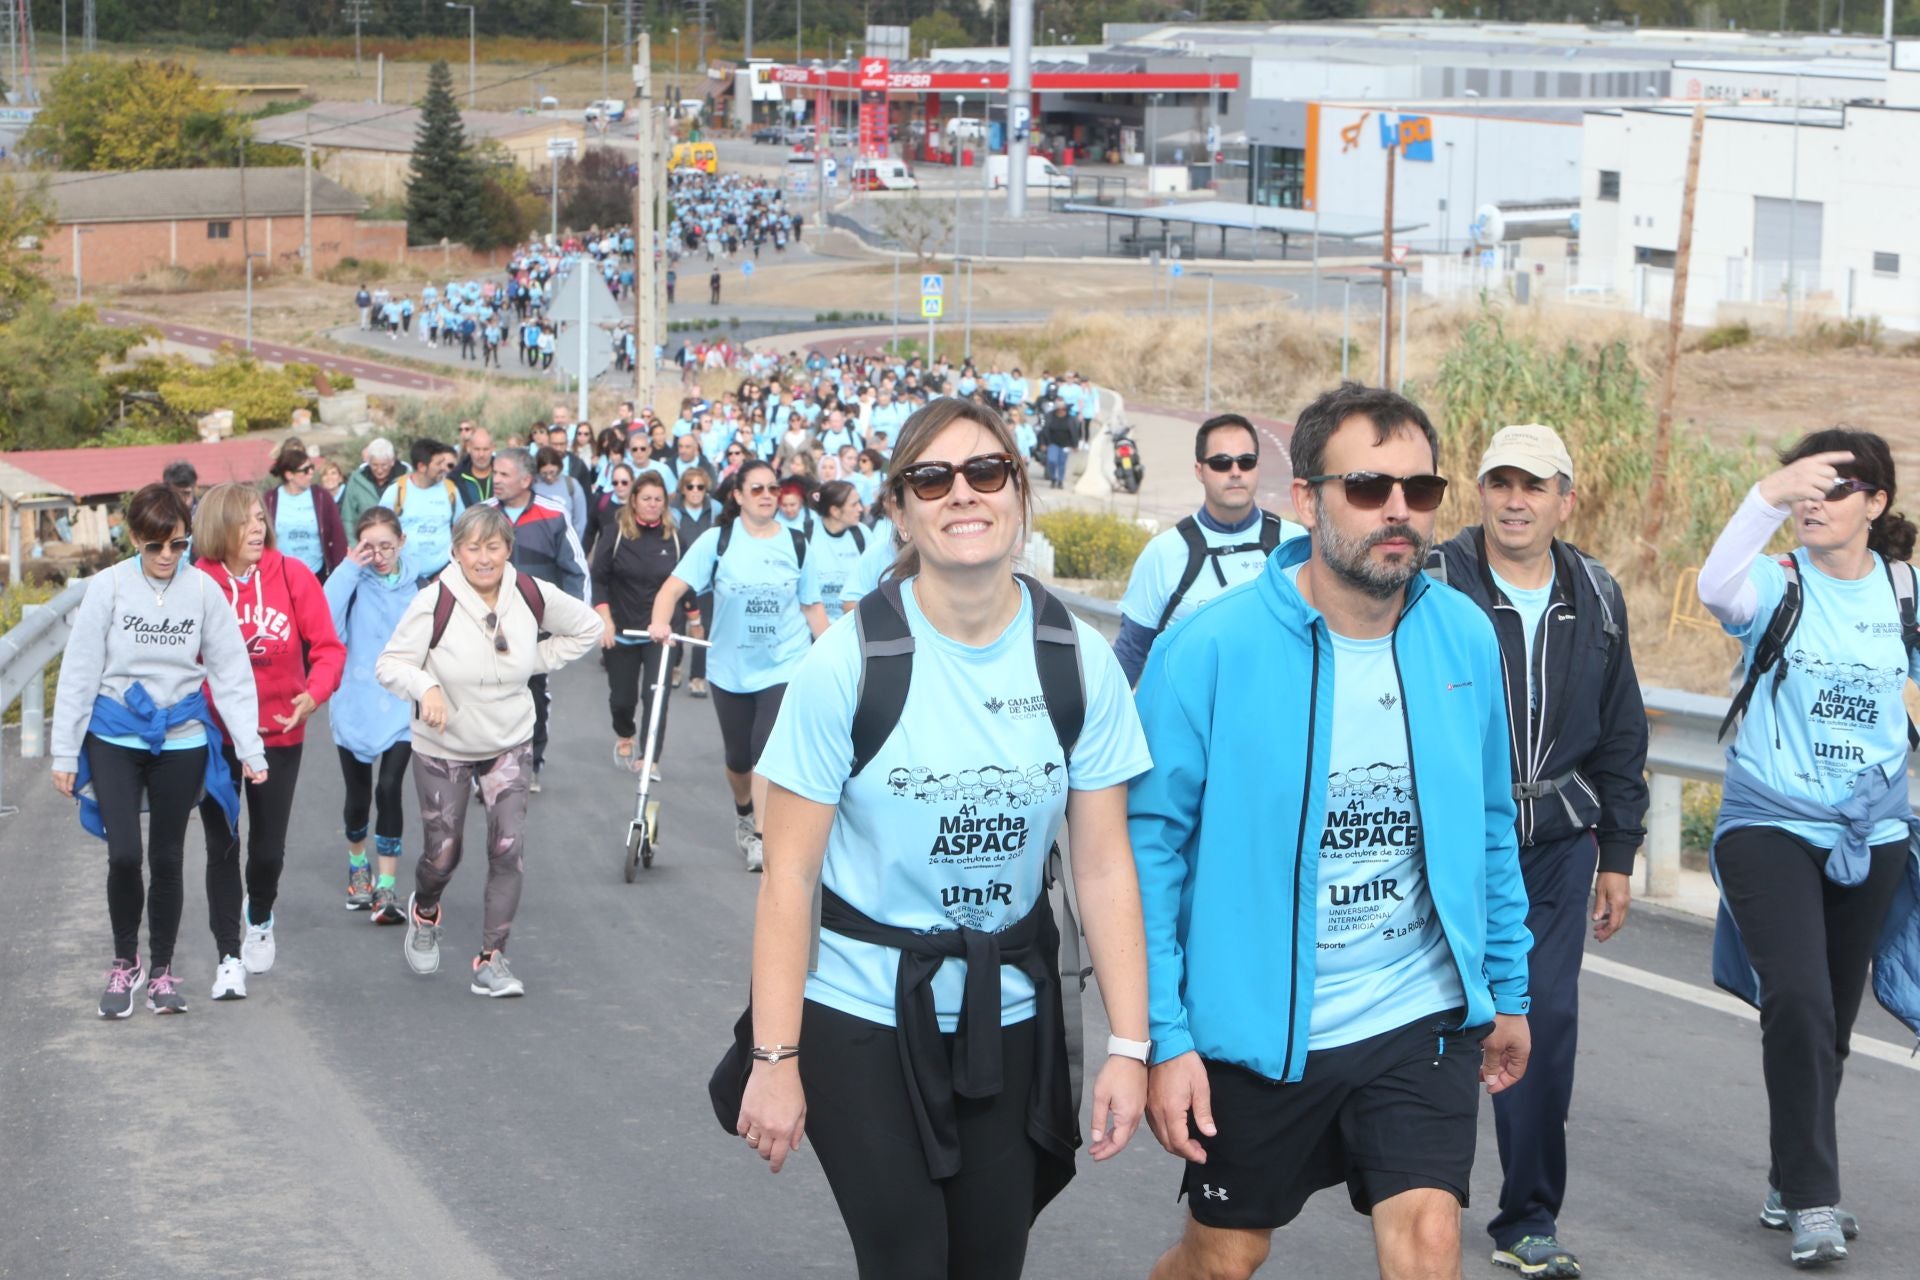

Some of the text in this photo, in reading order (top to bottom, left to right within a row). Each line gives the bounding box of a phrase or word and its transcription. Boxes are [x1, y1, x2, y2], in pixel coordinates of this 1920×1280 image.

[123, 615, 196, 634] Hackett
[136, 634, 186, 645] LONDON
[1833, 684, 1845, 693] 41
[1008, 697, 1029, 706] CAJA
[1818, 689, 1876, 709] Marcha
[1009, 706, 1021, 714] DE
[1810, 702, 1879, 724] ASPACE
[959, 803, 977, 818] 41
[1347, 799, 1365, 813] 41
[940, 813, 1026, 834] Marcha
[1327, 807, 1411, 828] Marcha
[930, 828, 1029, 856] ASPACE
[1319, 825, 1418, 850] ASPACE
[941, 856, 954, 864] de
[957, 854, 992, 864] octubre
[1330, 851, 1343, 859] de
[1345, 849, 1378, 859] octubre
[1380, 848, 1392, 856] de
[1329, 905, 1380, 916] UNIVERSIDAD
[1328, 912, 1392, 924] INTERNACIONAL
[1353, 923, 1376, 931] RIOJA
[1397, 916, 1426, 937] La Rioja
